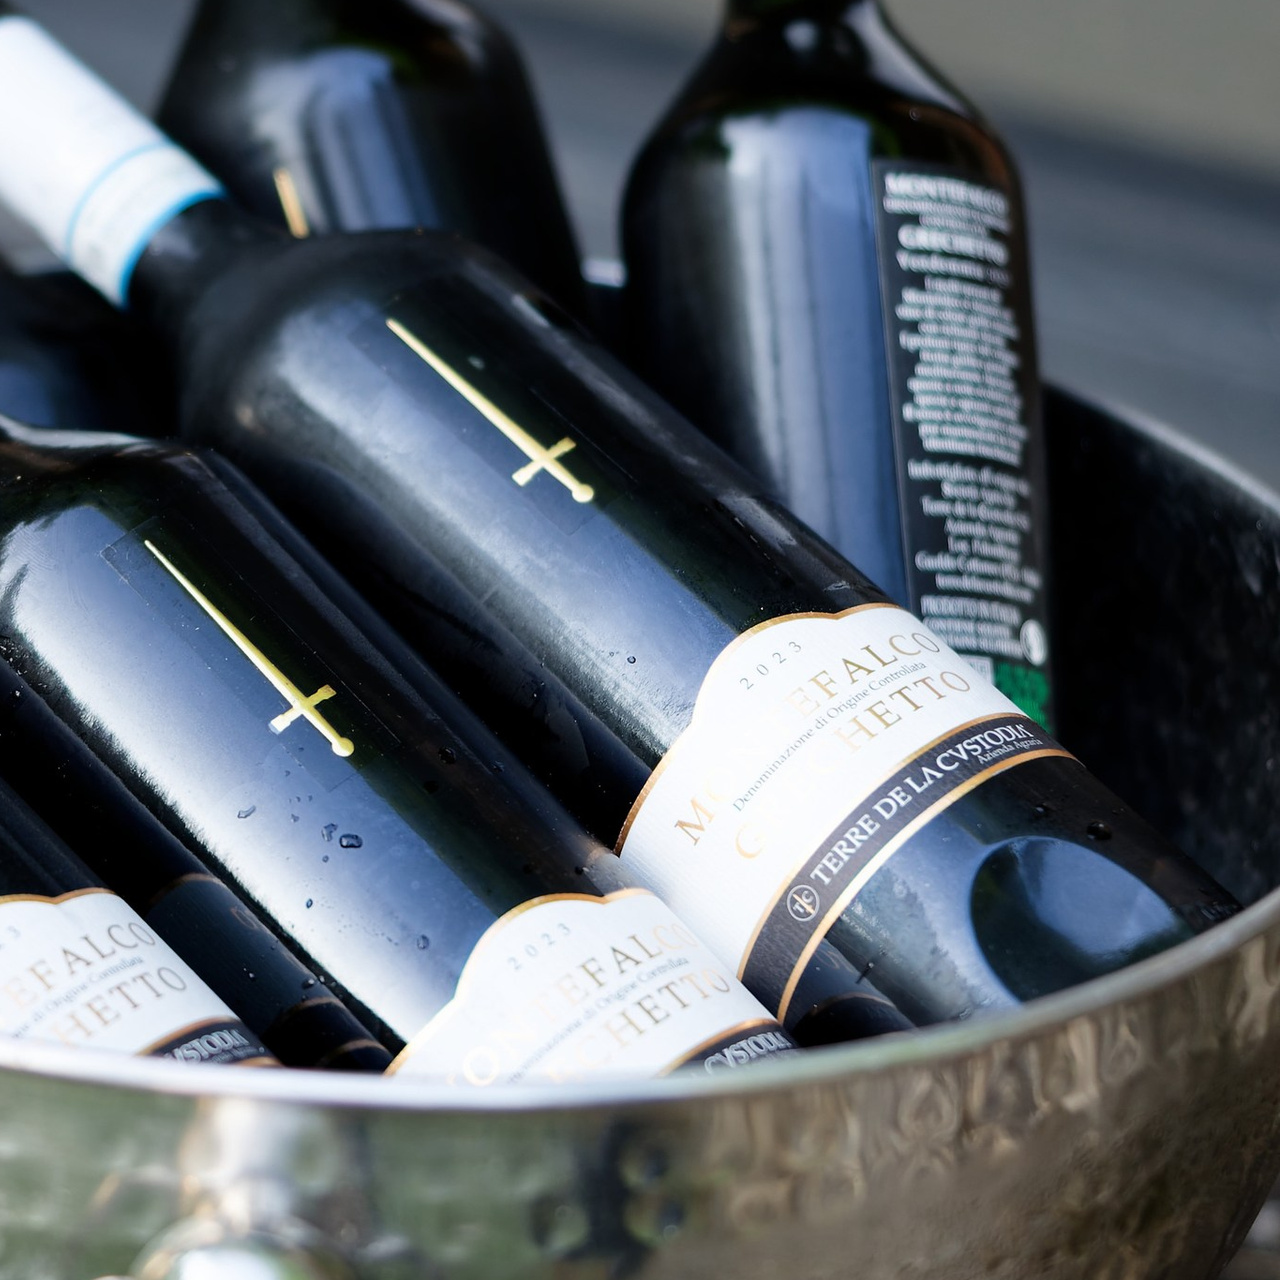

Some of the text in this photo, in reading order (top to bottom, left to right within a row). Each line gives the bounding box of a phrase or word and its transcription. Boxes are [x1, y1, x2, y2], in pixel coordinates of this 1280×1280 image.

[739, 640, 802, 690] 2023
[732, 659, 927, 812] Denominazione di Origine Controllata
[976, 744, 1015, 765] Azienda
[810, 723, 1034, 886] TERRE DE LA CVSTODIA
[506, 921, 572, 971] 2023
